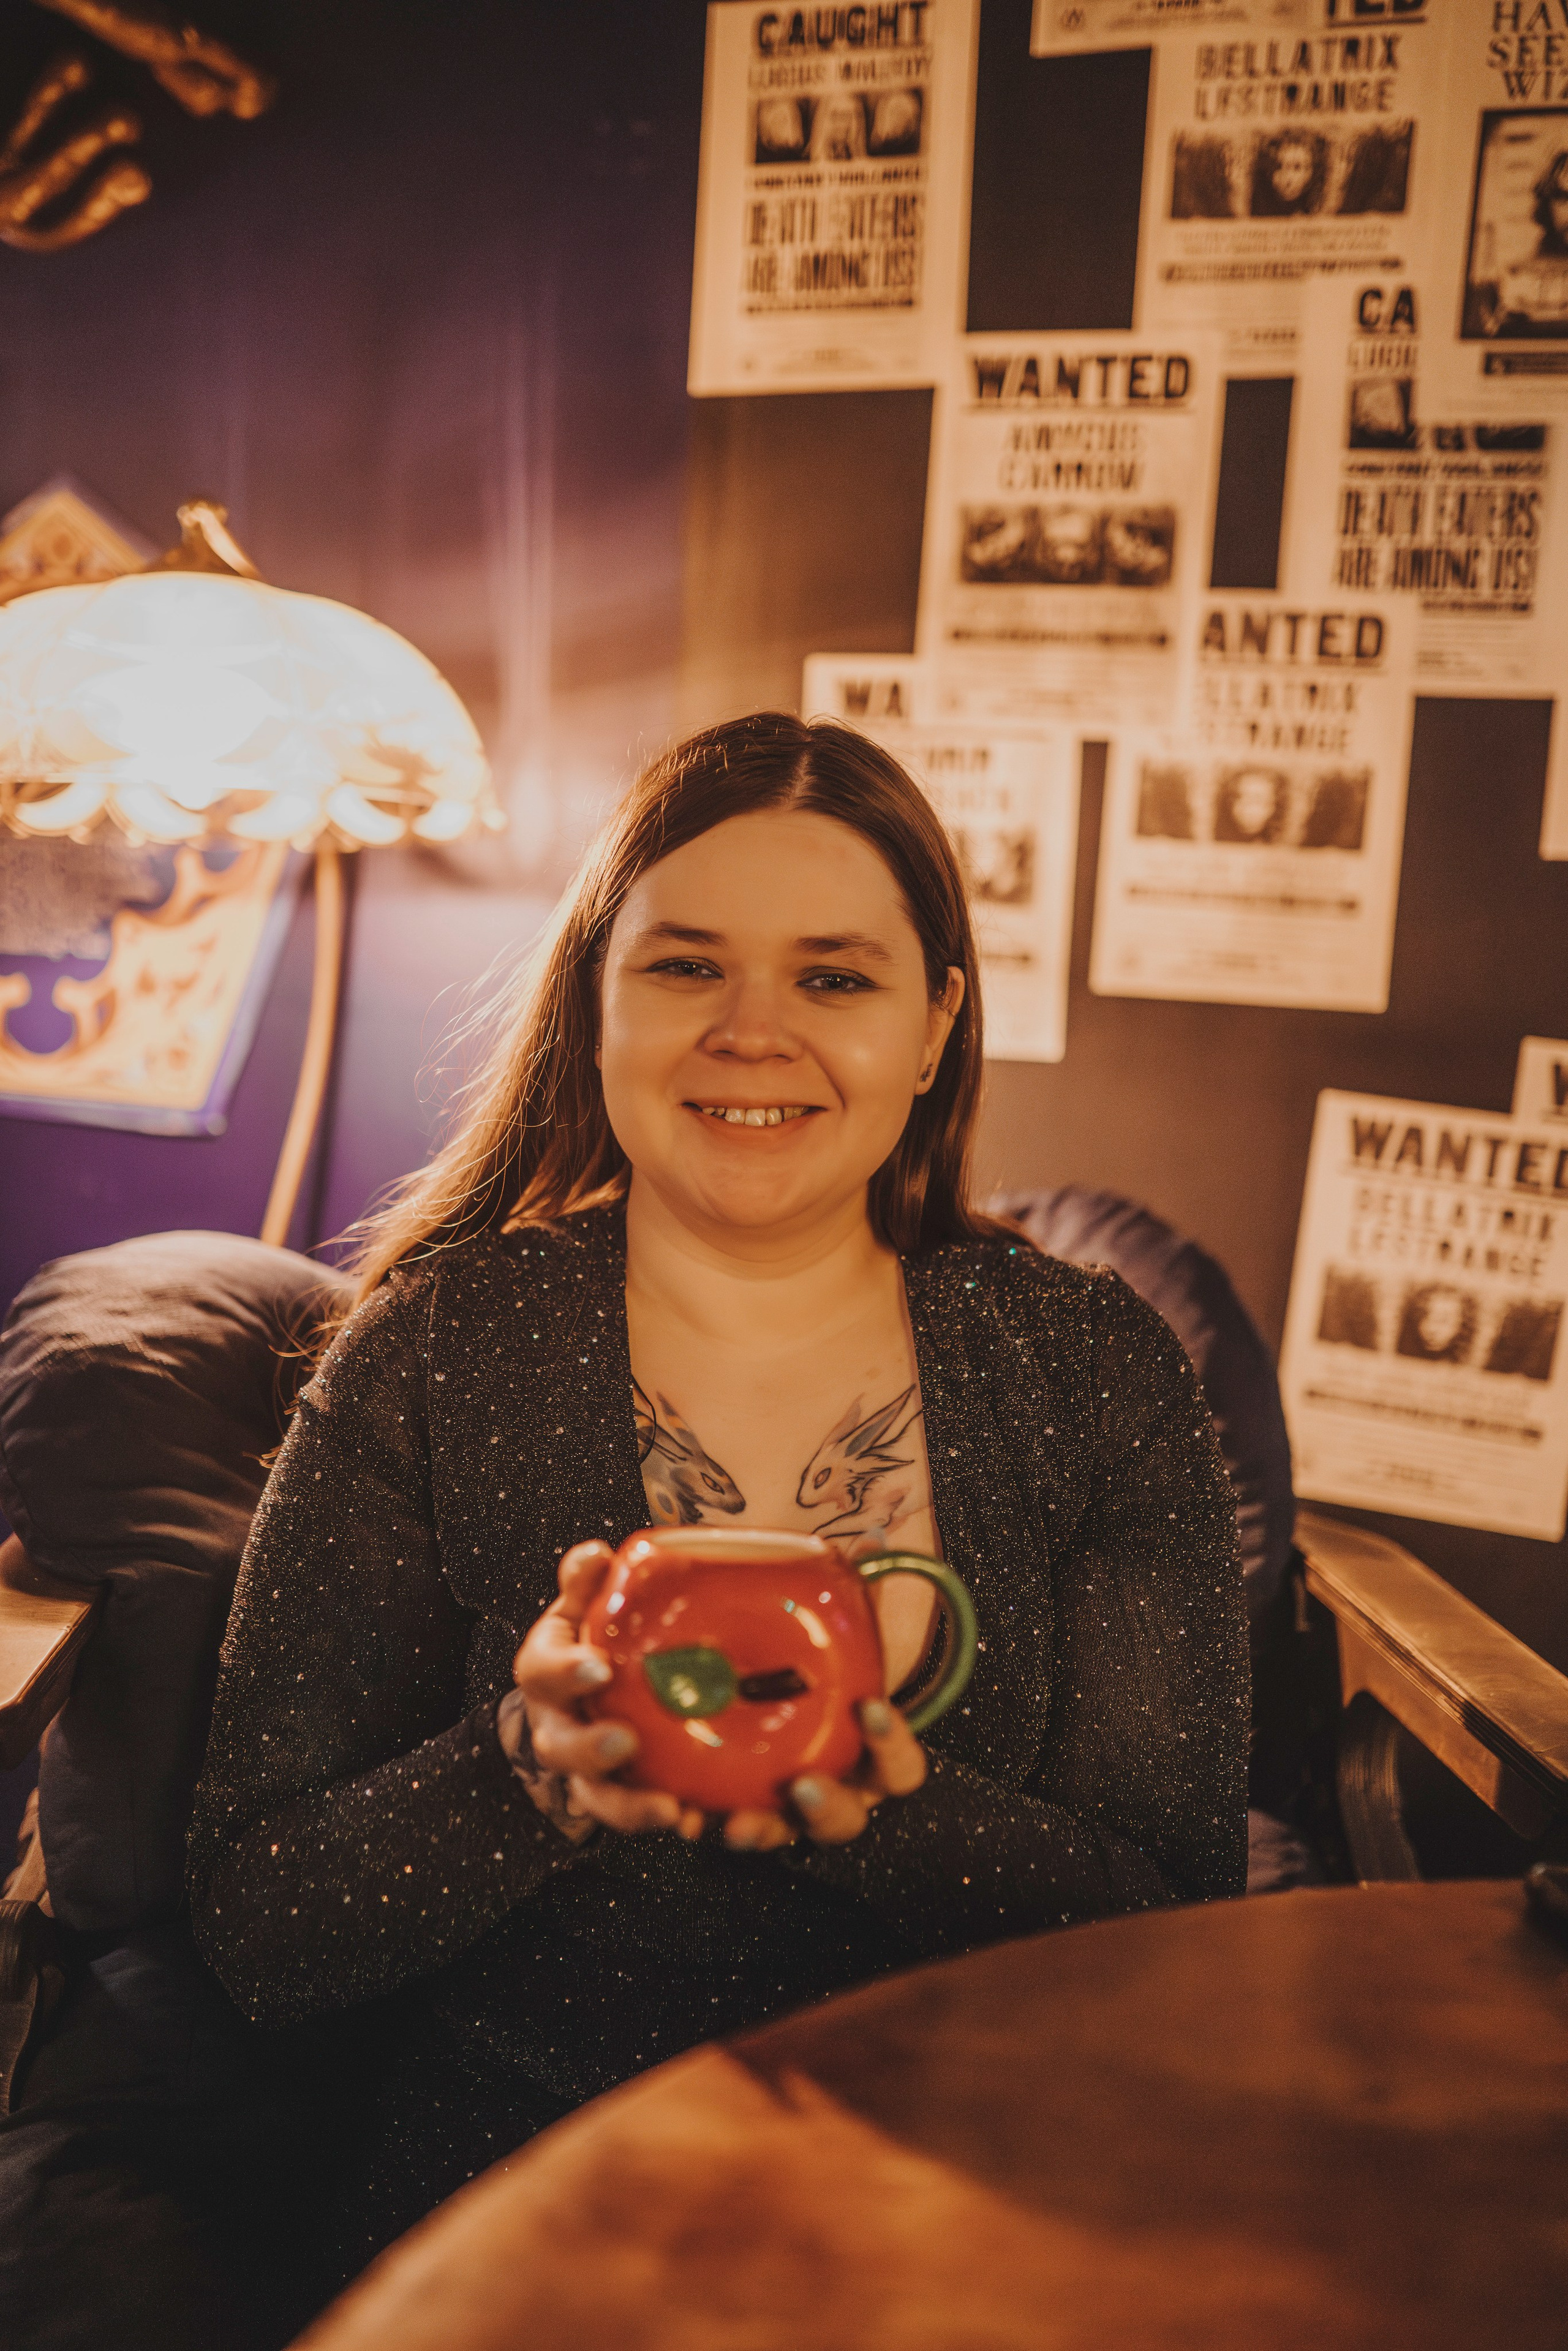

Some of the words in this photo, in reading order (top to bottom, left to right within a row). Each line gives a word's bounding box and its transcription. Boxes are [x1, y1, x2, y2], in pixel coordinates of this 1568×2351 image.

[757, 0, 930, 57] CAUGHT
[1194, 34, 1401, 81] BELLATRIX
[1358, 287, 1416, 334] CA
[973, 353, 1190, 403] WANTED
[842, 679, 907, 720] WA
